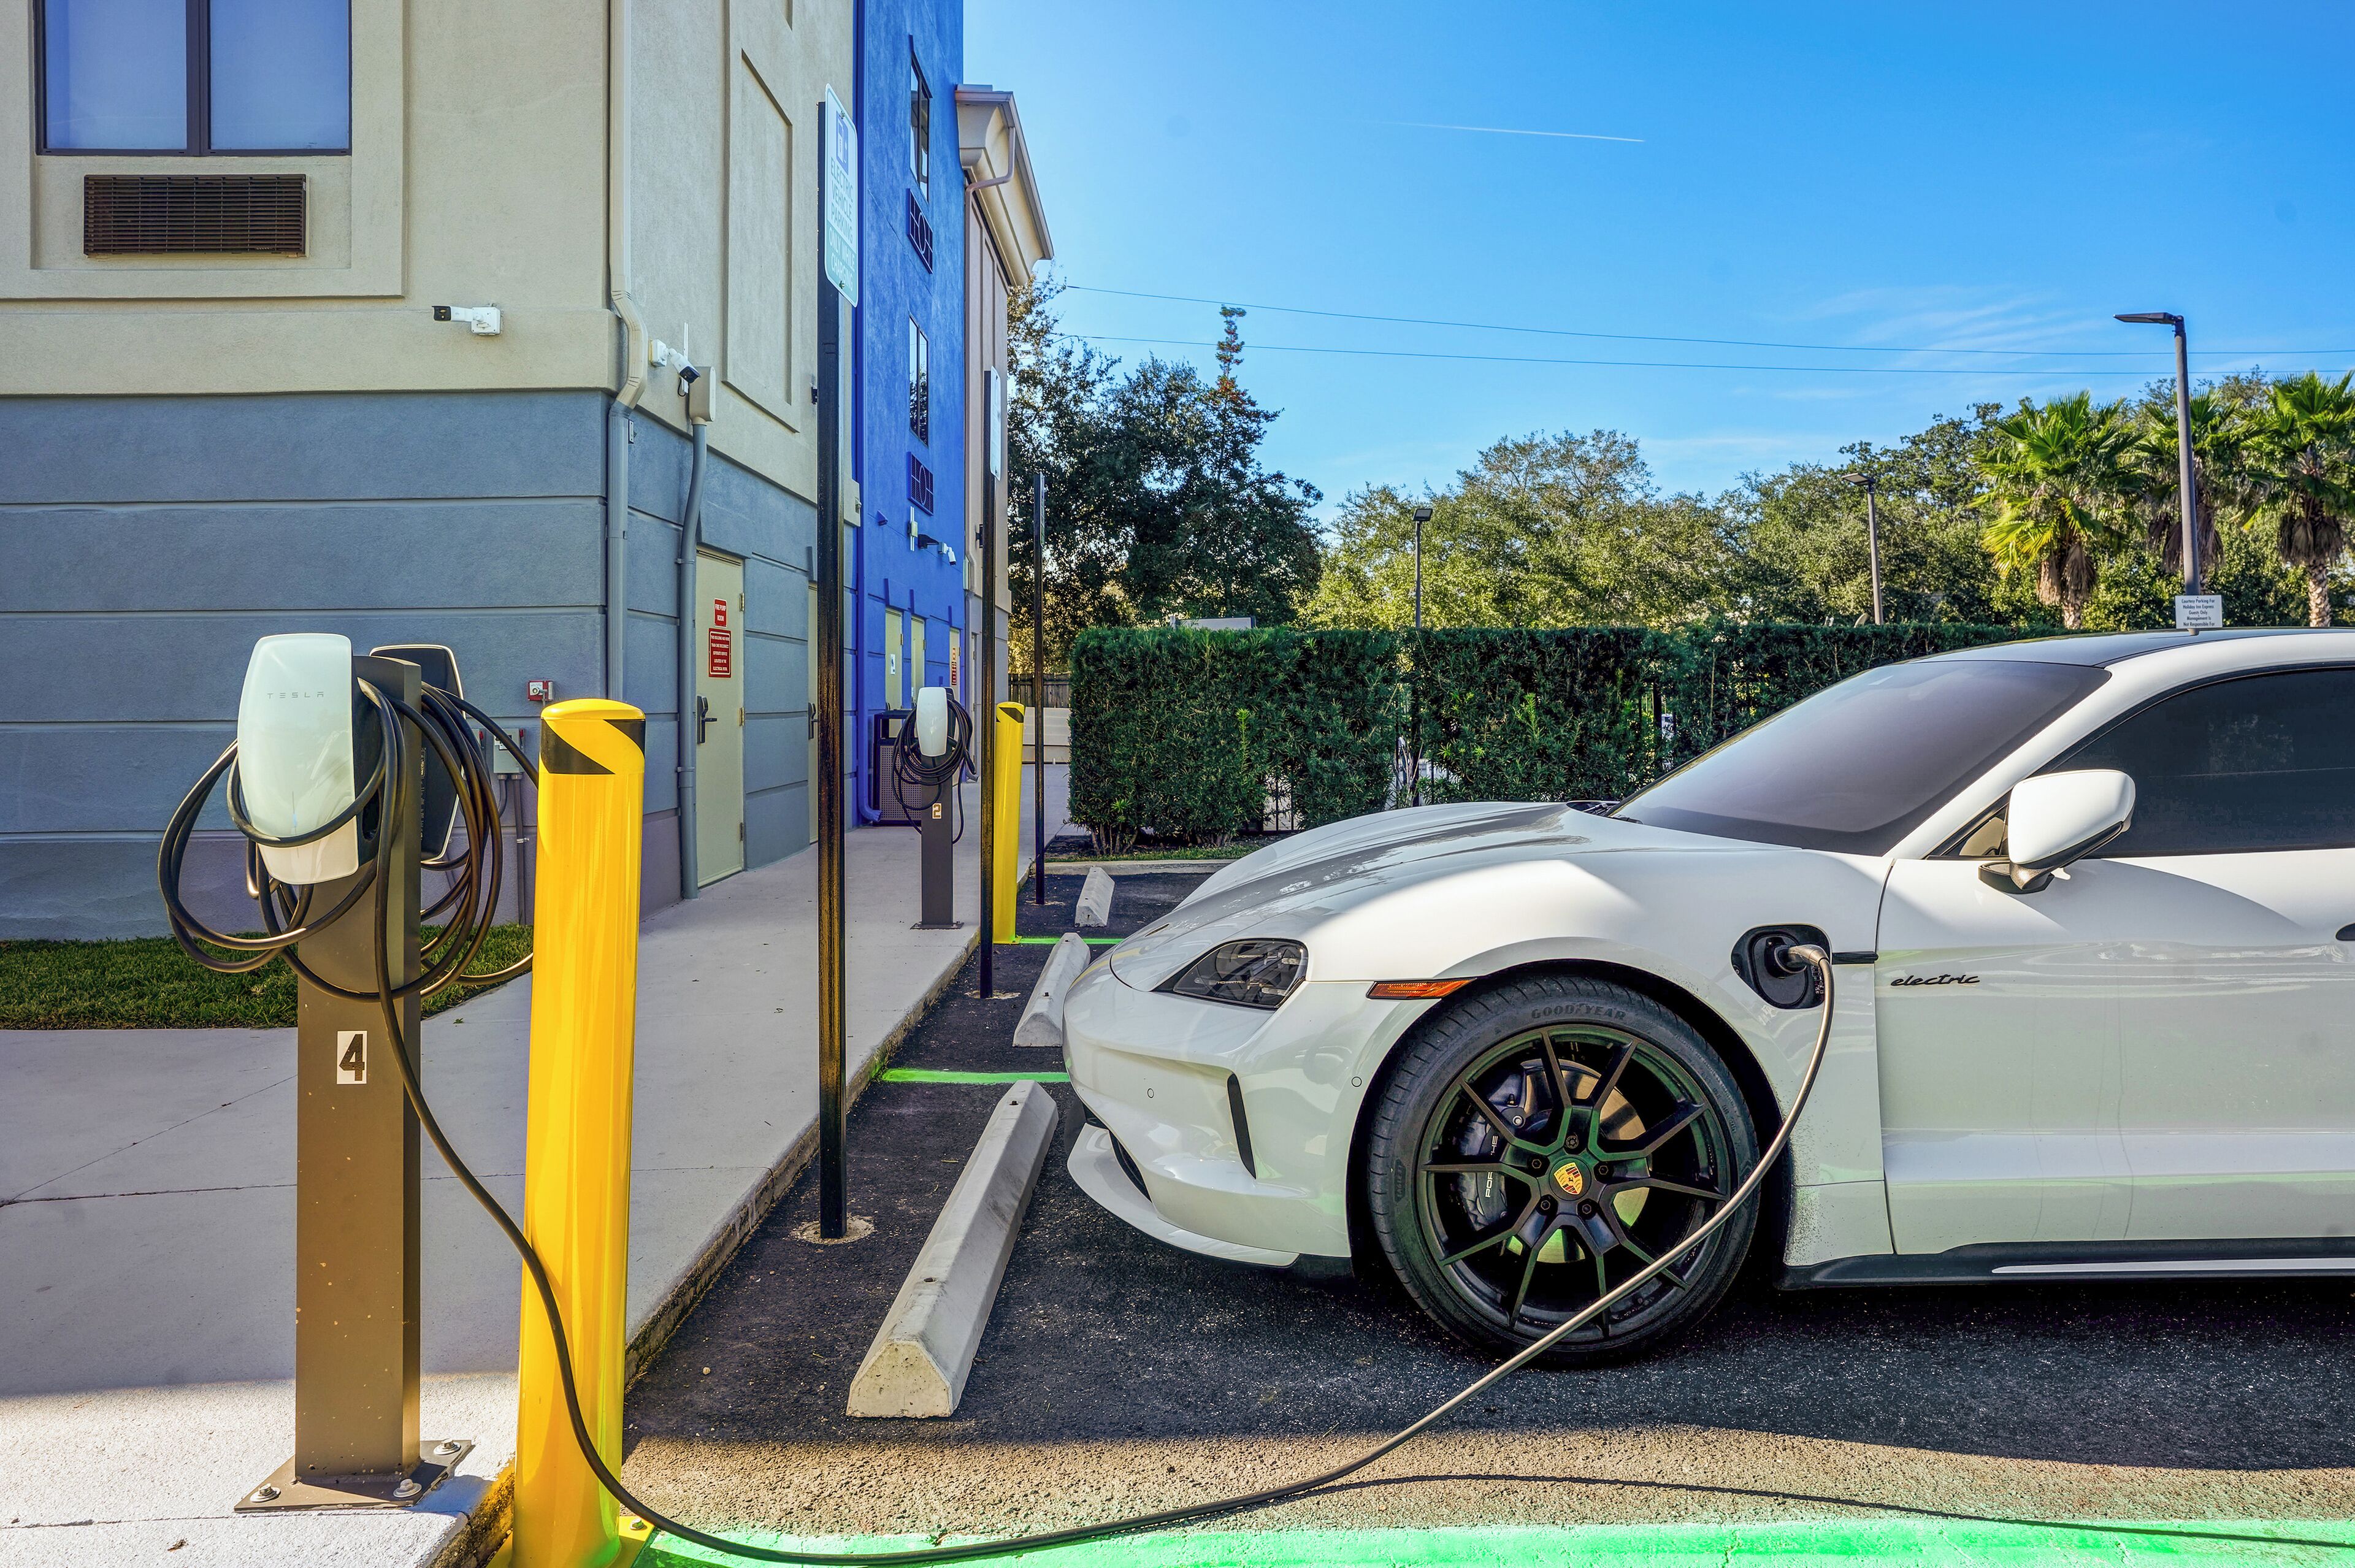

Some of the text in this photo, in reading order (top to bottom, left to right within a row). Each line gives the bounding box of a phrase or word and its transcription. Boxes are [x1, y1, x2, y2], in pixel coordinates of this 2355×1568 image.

[830, 157, 853, 203] ELECTRIC
[832, 179, 852, 221] VEHICLE
[831, 202, 852, 243] PARKING
[829, 226, 855, 272] ONLY WHILE
[831, 252, 853, 291] CHARGING
[933, 804, 941, 818] 2
[1891, 974, 1980, 986] electric
[339, 1034, 365, 1081] 4
[1485, 1135, 1498, 1198] PORHE
